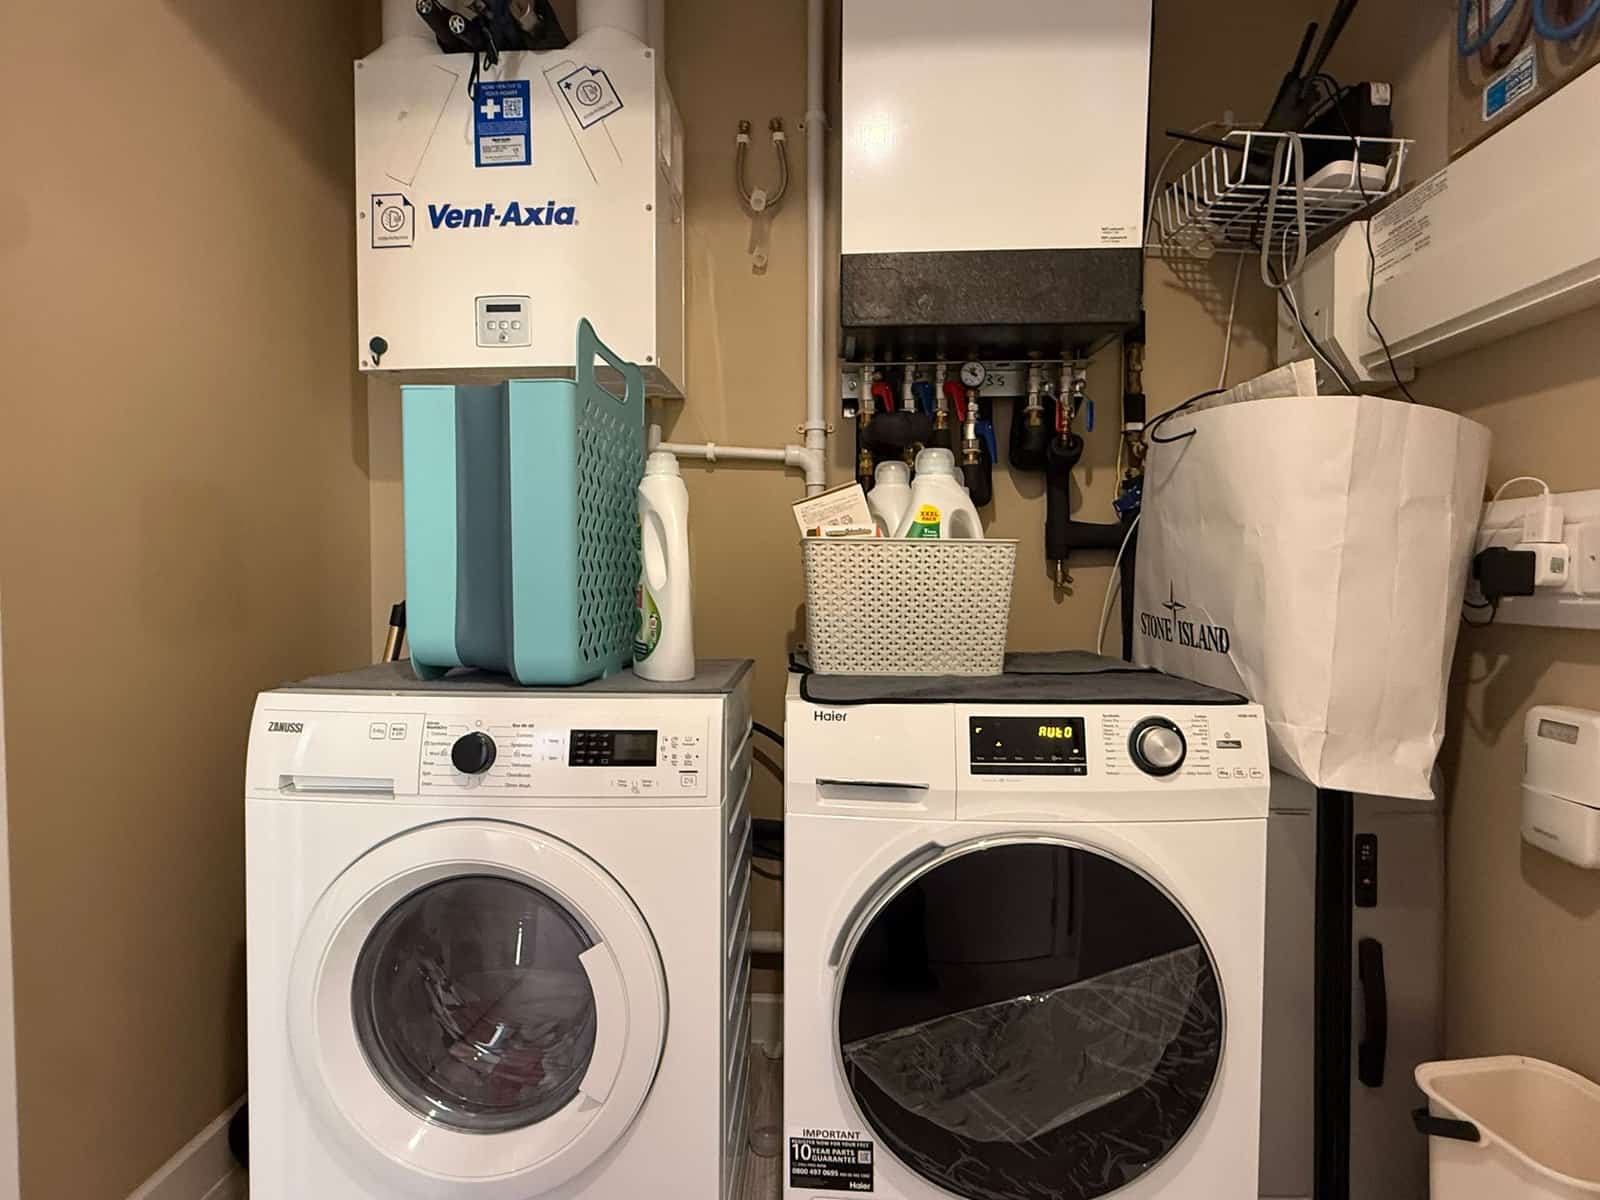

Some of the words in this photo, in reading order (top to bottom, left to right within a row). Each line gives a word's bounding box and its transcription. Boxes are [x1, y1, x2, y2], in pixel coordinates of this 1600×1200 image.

[428, 201, 575, 228] Vent-Axia
[1141, 612, 1173, 642] STONE
[1178, 620, 1230, 654] ISLAND
[814, 711, 847, 722] Haier
[268, 722, 304, 734] ZANUSSI
[802, 1128, 861, 1140] IMPORTANT
[792, 1143, 812, 1161] 10
[812, 1147, 831, 1155] YEAR
[831, 1148, 855, 1156] PARTS
[812, 1155, 856, 1164] GUARANTEE
[849, 1181, 871, 1190] Haier
